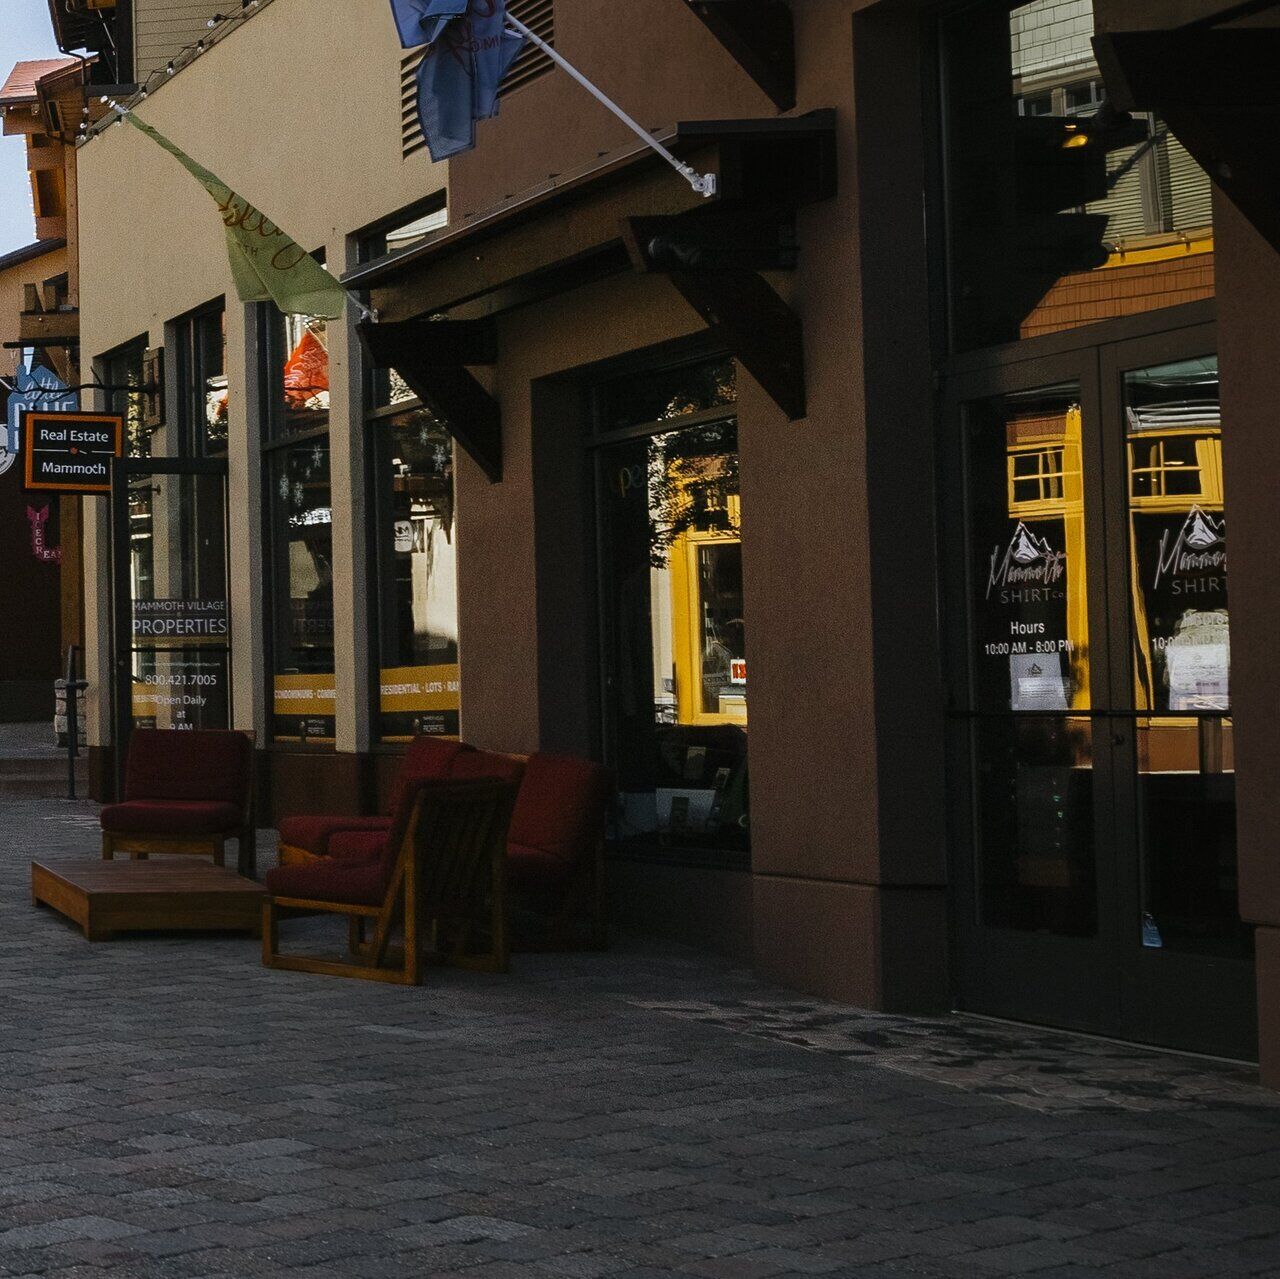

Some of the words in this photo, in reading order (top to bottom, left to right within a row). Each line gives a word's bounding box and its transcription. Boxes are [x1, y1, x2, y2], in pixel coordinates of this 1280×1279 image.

[40, 429, 67, 441] Real
[70, 430, 109, 443] Estate
[41, 462, 106, 475] Mammoth
[1000, 587, 1051, 604] SHIRT
[134, 601, 185, 611] MAMMOTH
[186, 601, 225, 610] VILLAGE
[133, 619, 227, 634] PROPERTIES
[1010, 621, 1045, 634] Hours
[985, 642, 1010, 655] 10:00
[1011, 642, 1027, 653] AM
[1058, 640, 1075, 652] PM
[145, 674, 217, 685] 800.421.7005
[380, 683, 421, 696] RESIDENTIAL
[426, 681, 443, 693] LOTS
[156, 694, 181, 705] Open
[183, 694, 207, 706] Daily
